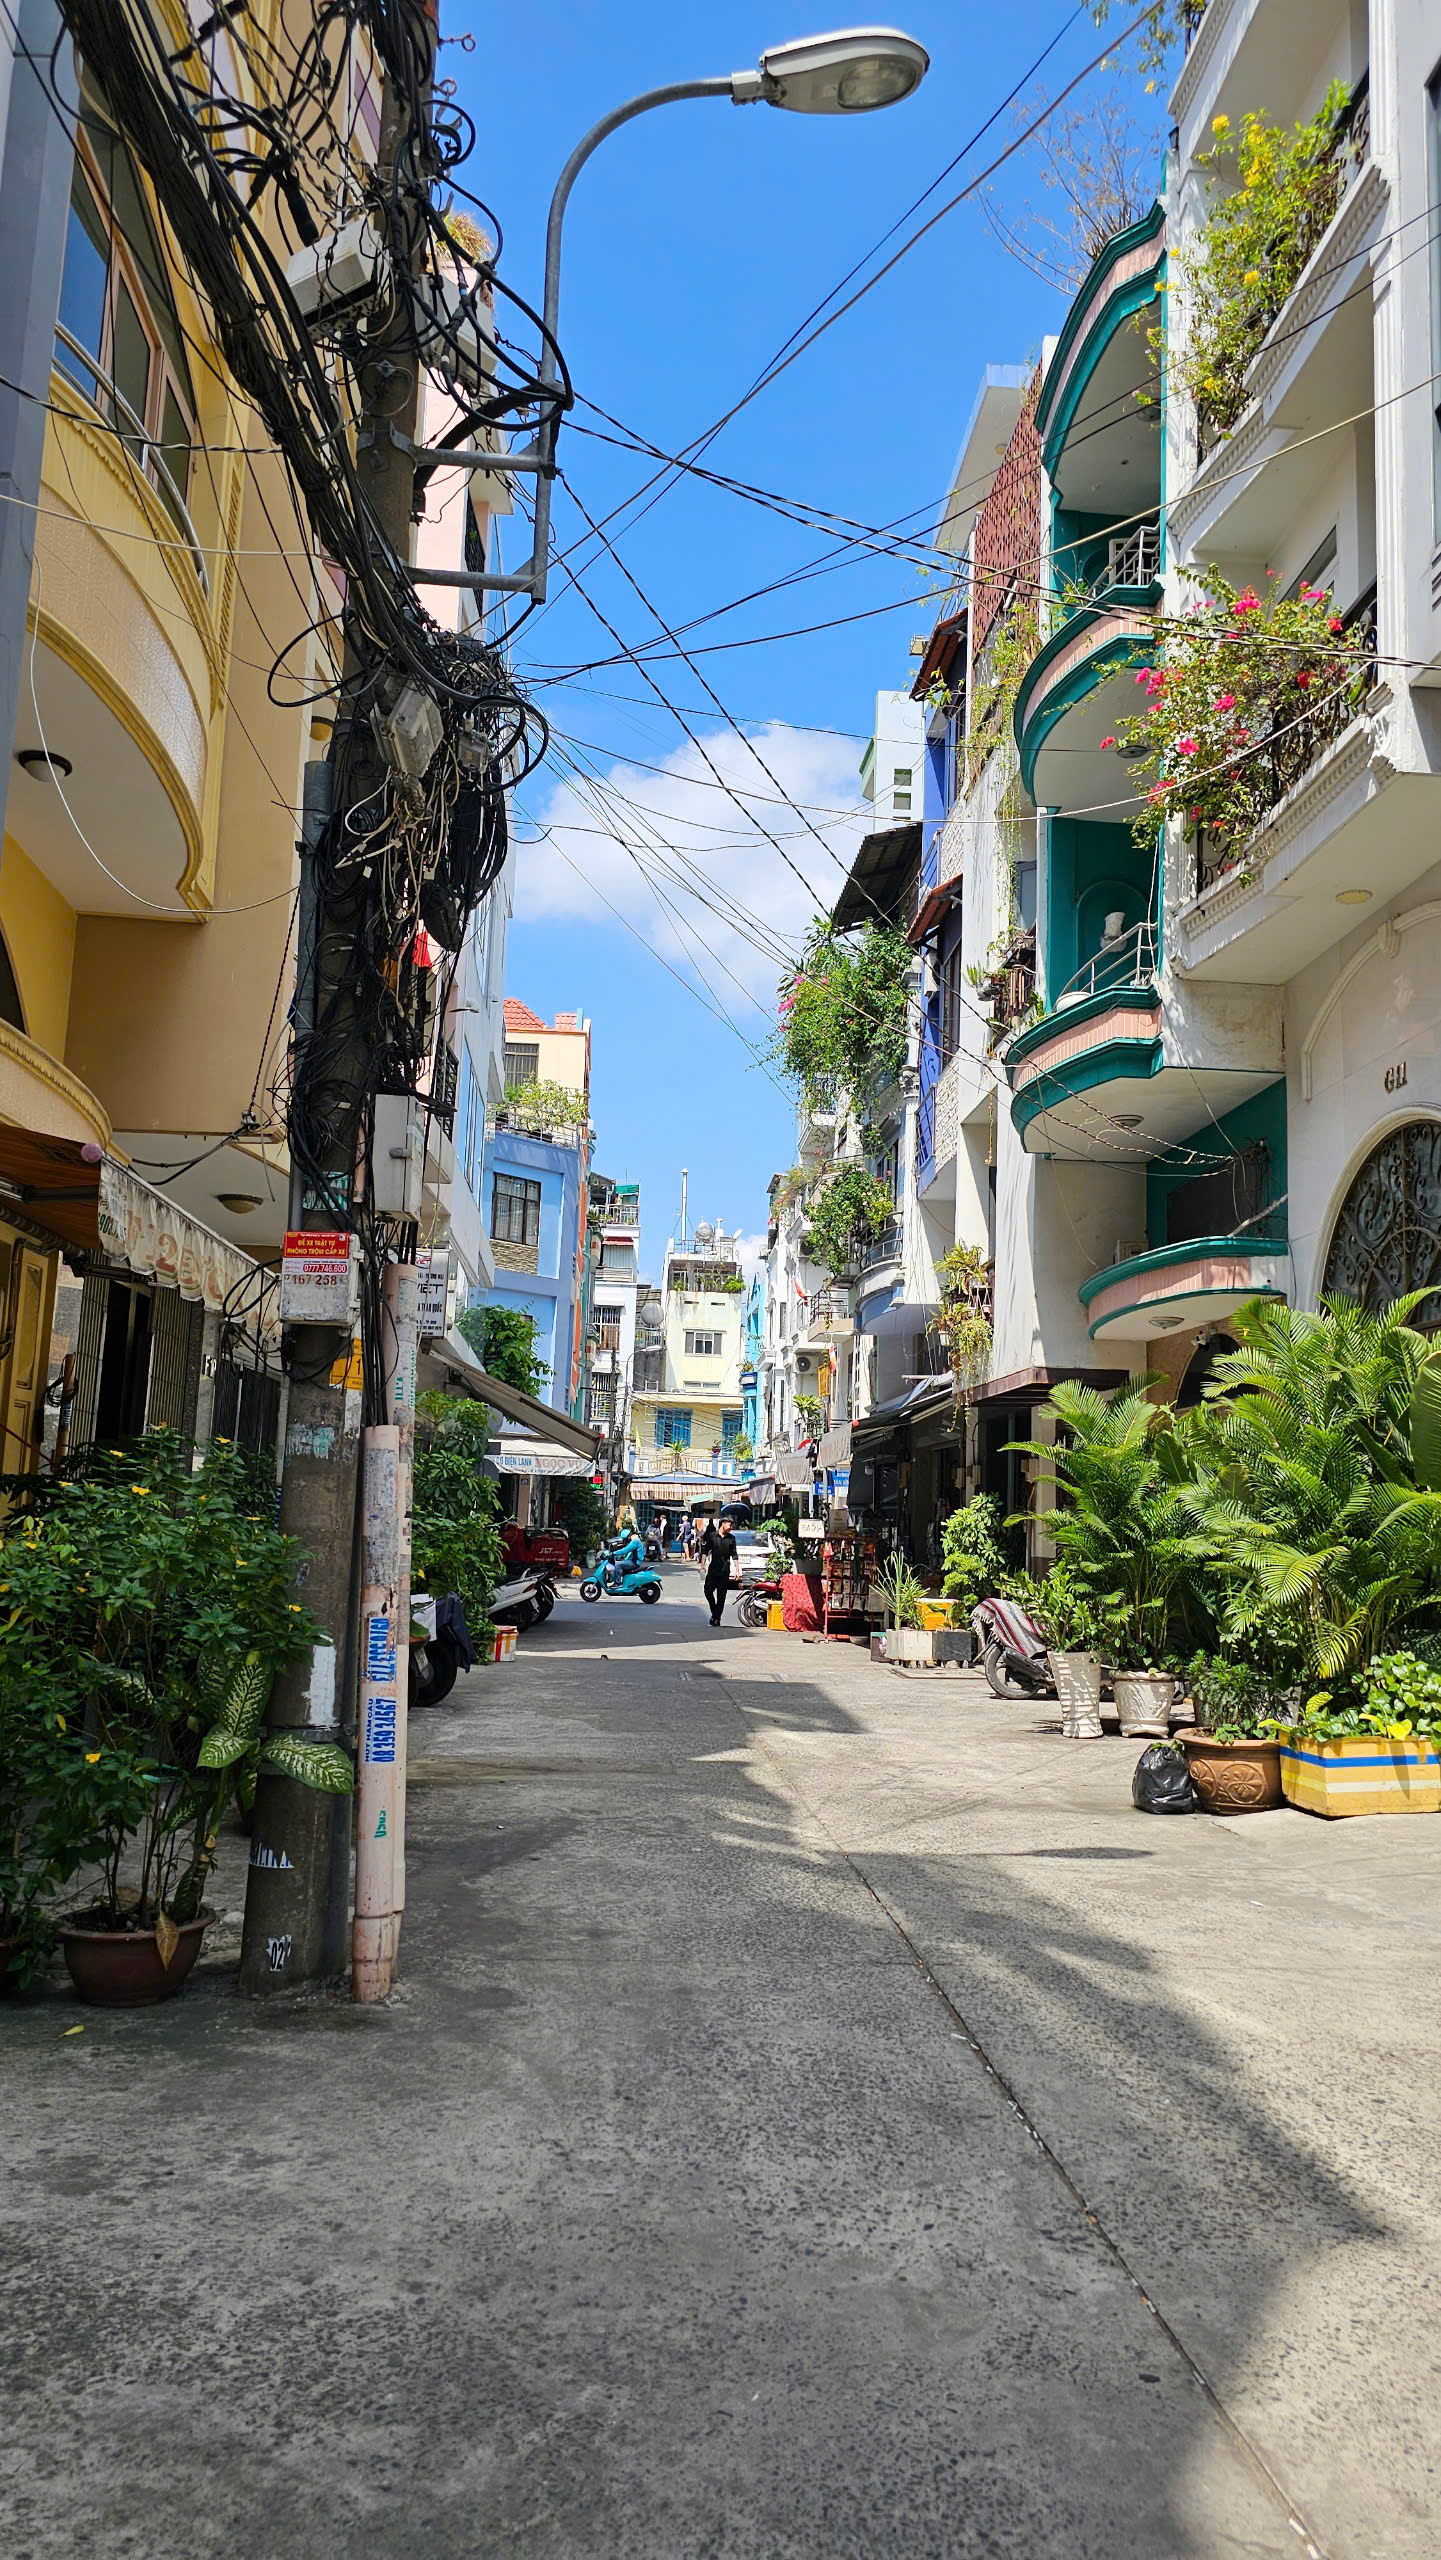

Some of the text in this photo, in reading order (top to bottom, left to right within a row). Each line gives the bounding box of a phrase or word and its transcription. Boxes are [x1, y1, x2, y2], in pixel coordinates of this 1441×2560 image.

[371, 1698, 396, 1762] 08 359 34567
